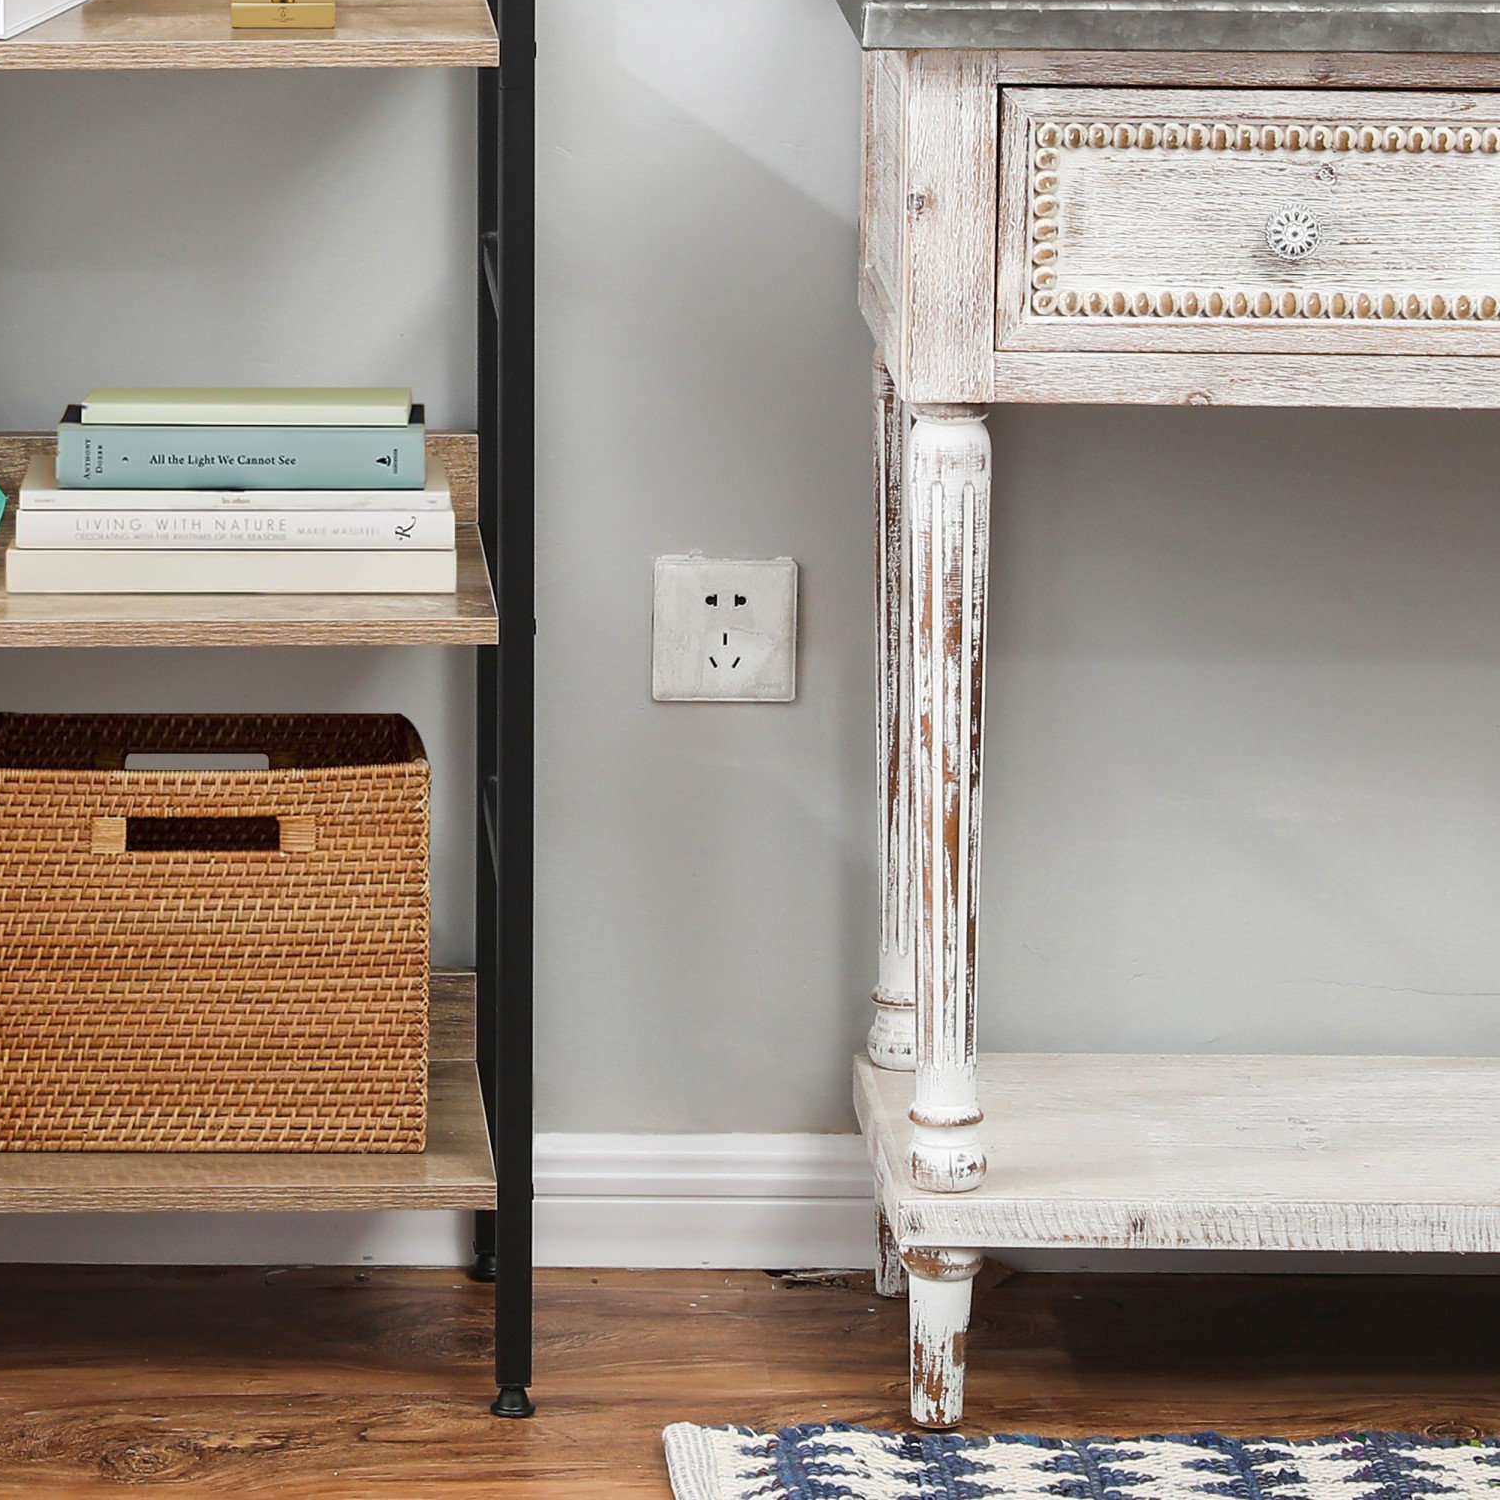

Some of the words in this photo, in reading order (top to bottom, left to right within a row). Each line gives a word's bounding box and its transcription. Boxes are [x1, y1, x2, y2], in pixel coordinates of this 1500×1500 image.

[149, 455, 165, 464] All
[168, 455, 184, 464] the
[188, 455, 215, 467] Light
[217, 455, 234, 464] We
[237, 455, 275, 465] Cannot
[278, 455, 296, 464] See
[76, 519, 142, 530] LIVING
[155, 519, 201, 530] WITH
[215, 519, 286, 531] NATURE
